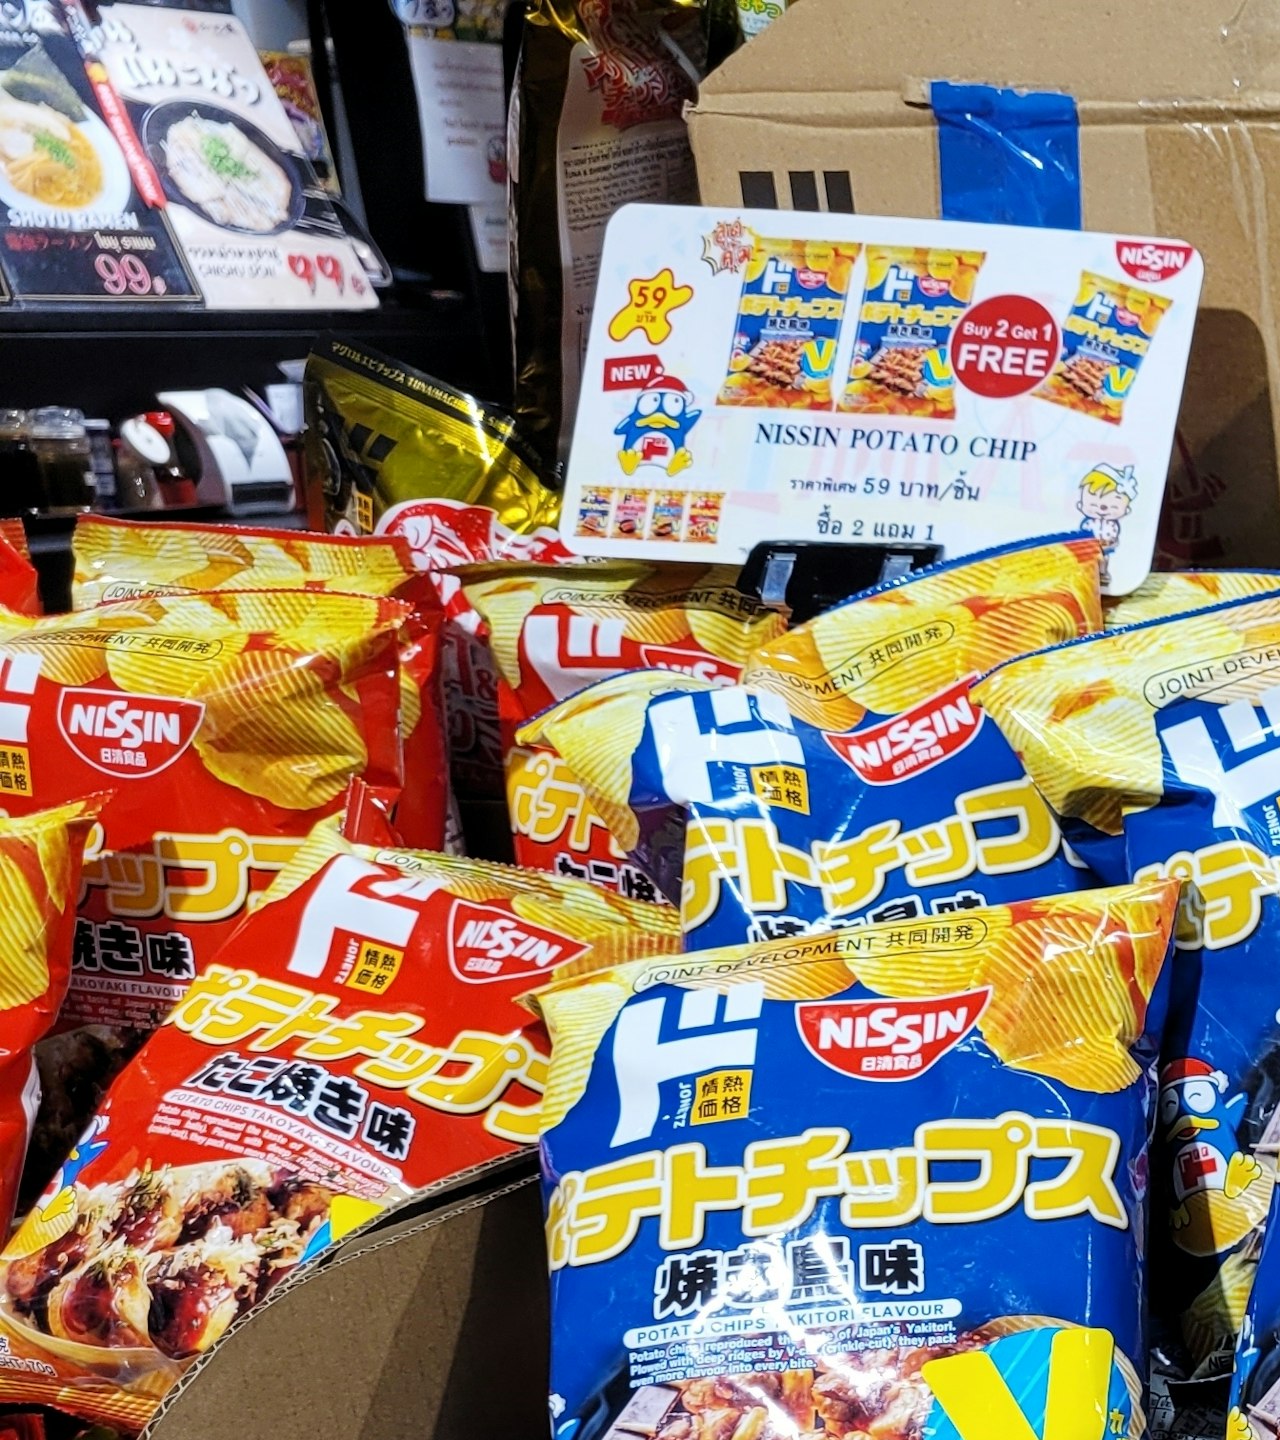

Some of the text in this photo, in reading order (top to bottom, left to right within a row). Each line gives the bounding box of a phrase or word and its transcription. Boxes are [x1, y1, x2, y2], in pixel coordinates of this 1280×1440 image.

[93, 252, 152, 296] 99
[286, 253, 346, 298] 99
[1121, 245, 1186, 270] NISSIN
[634, 286, 668, 309] 59
[962, 319, 1053, 341] Buy 2 Get 1
[610, 364, 651, 383] NEW
[956, 349, 1050, 379] FREE
[755, 422, 1038, 462] NISSIN POTATO CHIP
[789, 470, 980, 502] ราคาพิเศษ 59 บาท/ชิ้น
[816, 504, 935, 541] ซื้อ 2 แถม 1
[69, 700, 181, 749] NISSIN
[847, 695, 977, 771] NISSIN
[100, 747, 148, 768] 日清食品
[456, 918, 564, 967] NISSIN
[643, 923, 976, 985] JOINT DEVELOPMENT 共同開発
[818, 1006, 969, 1055] NISSIN
[860, 1053, 924, 1073] 日清食品
[185, 1050, 418, 1163] たこ焼き味
[673, 1081, 692, 1129] JONETZ
